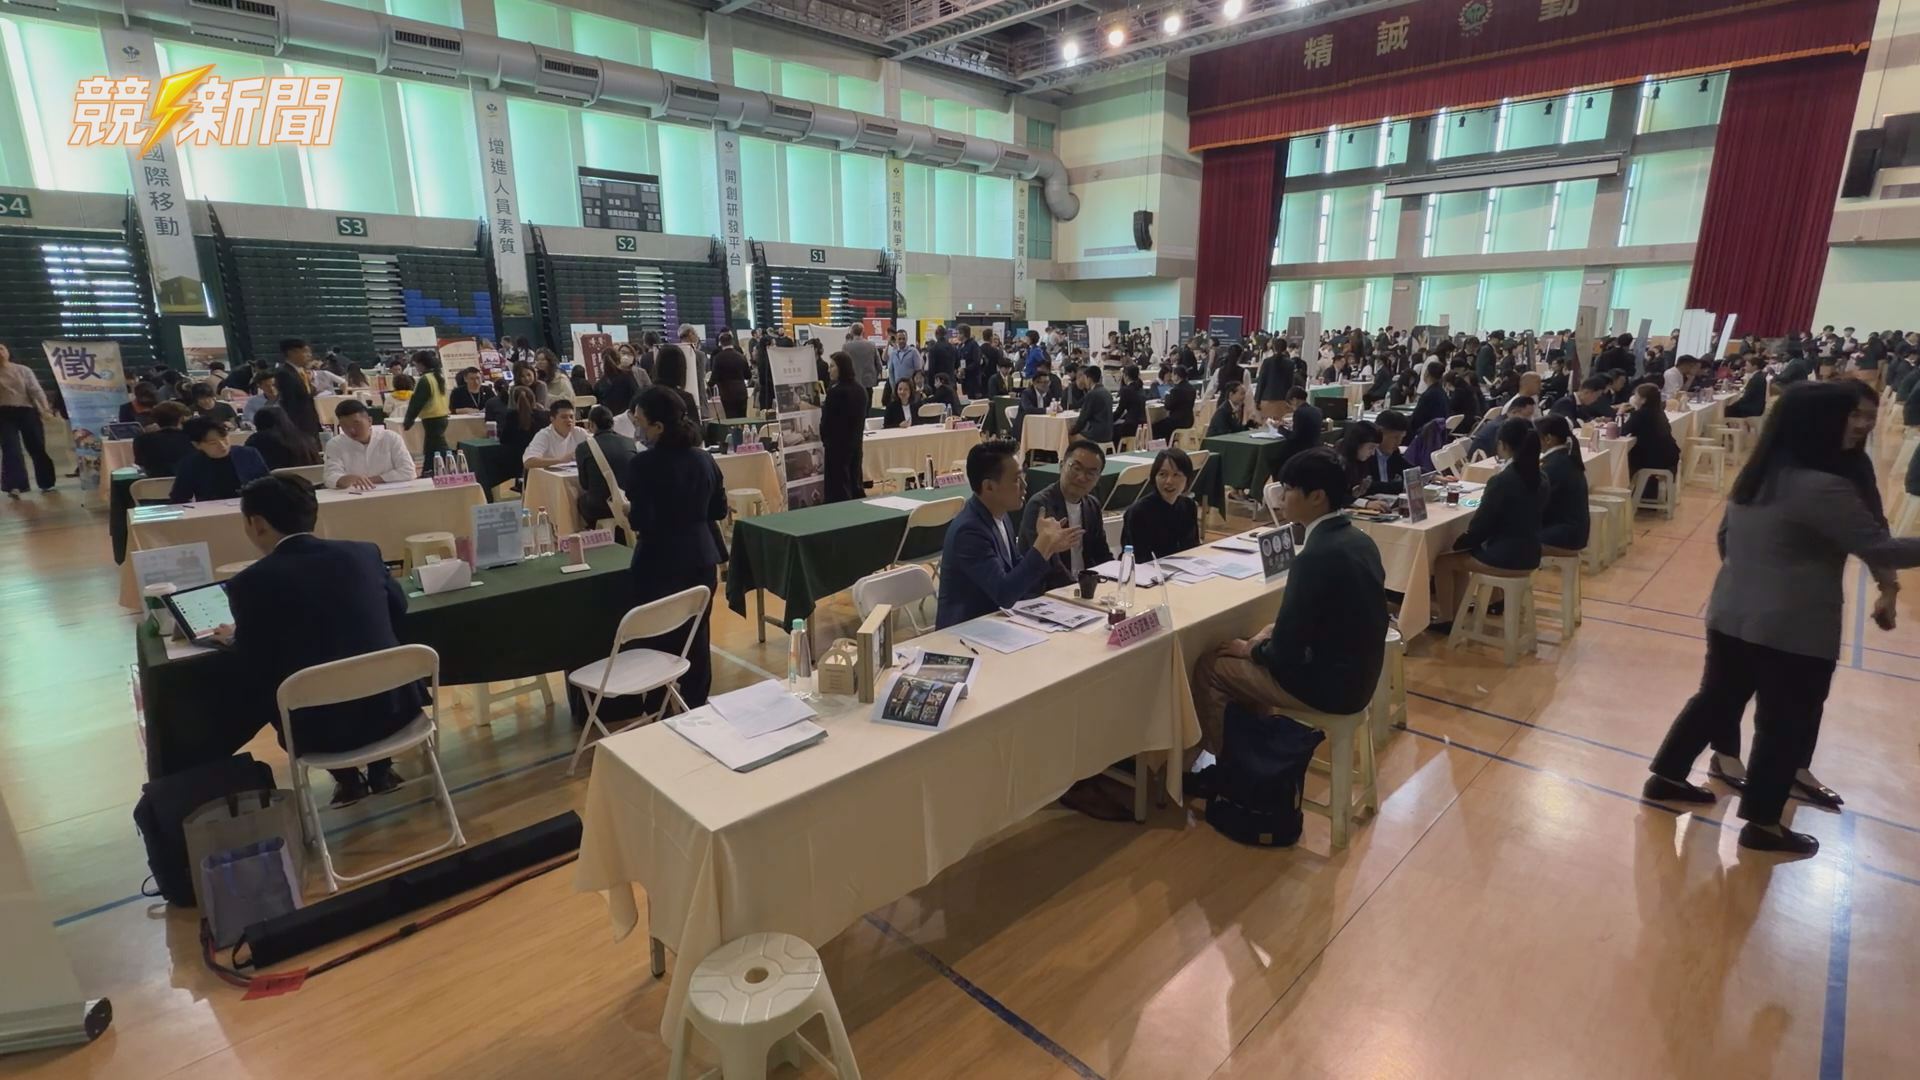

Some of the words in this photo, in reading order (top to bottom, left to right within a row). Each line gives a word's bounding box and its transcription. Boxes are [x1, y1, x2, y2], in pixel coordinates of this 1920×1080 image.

[488, 137, 517, 254] 增進人員素質
[339, 219, 365, 235] S3
[724, 168, 741, 266] 開創研發平台
[617, 237, 635, 250] S2
[811, 249, 825, 263] S1
[51, 345, 103, 381] 徵
